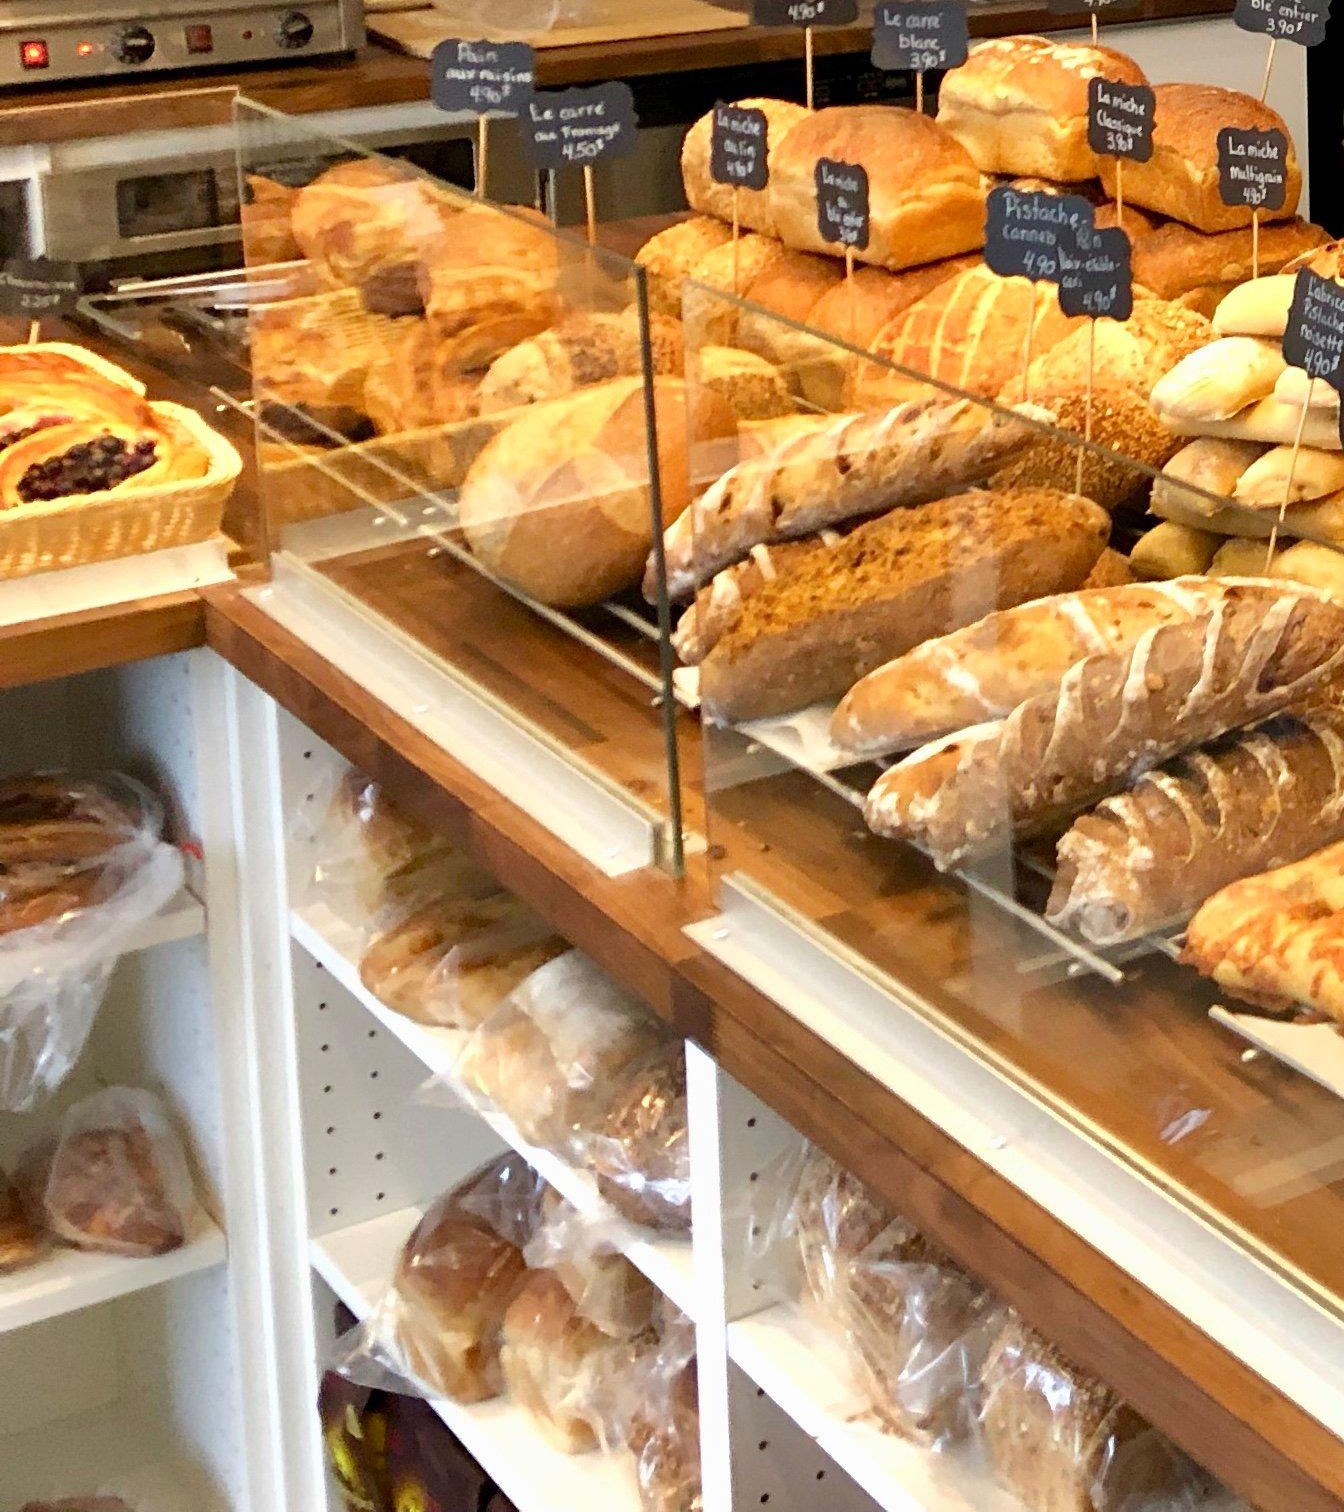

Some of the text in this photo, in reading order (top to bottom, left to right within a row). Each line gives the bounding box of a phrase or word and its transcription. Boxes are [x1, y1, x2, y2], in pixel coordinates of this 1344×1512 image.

[883, 8, 902, 28] Le
[1278, 4, 1320, 24] entier
[898, 34, 940, 50] blanc
[529, 102, 555, 123] Le
[1112, 93, 1146, 116] miche
[1228, 135, 1279, 160] La miche
